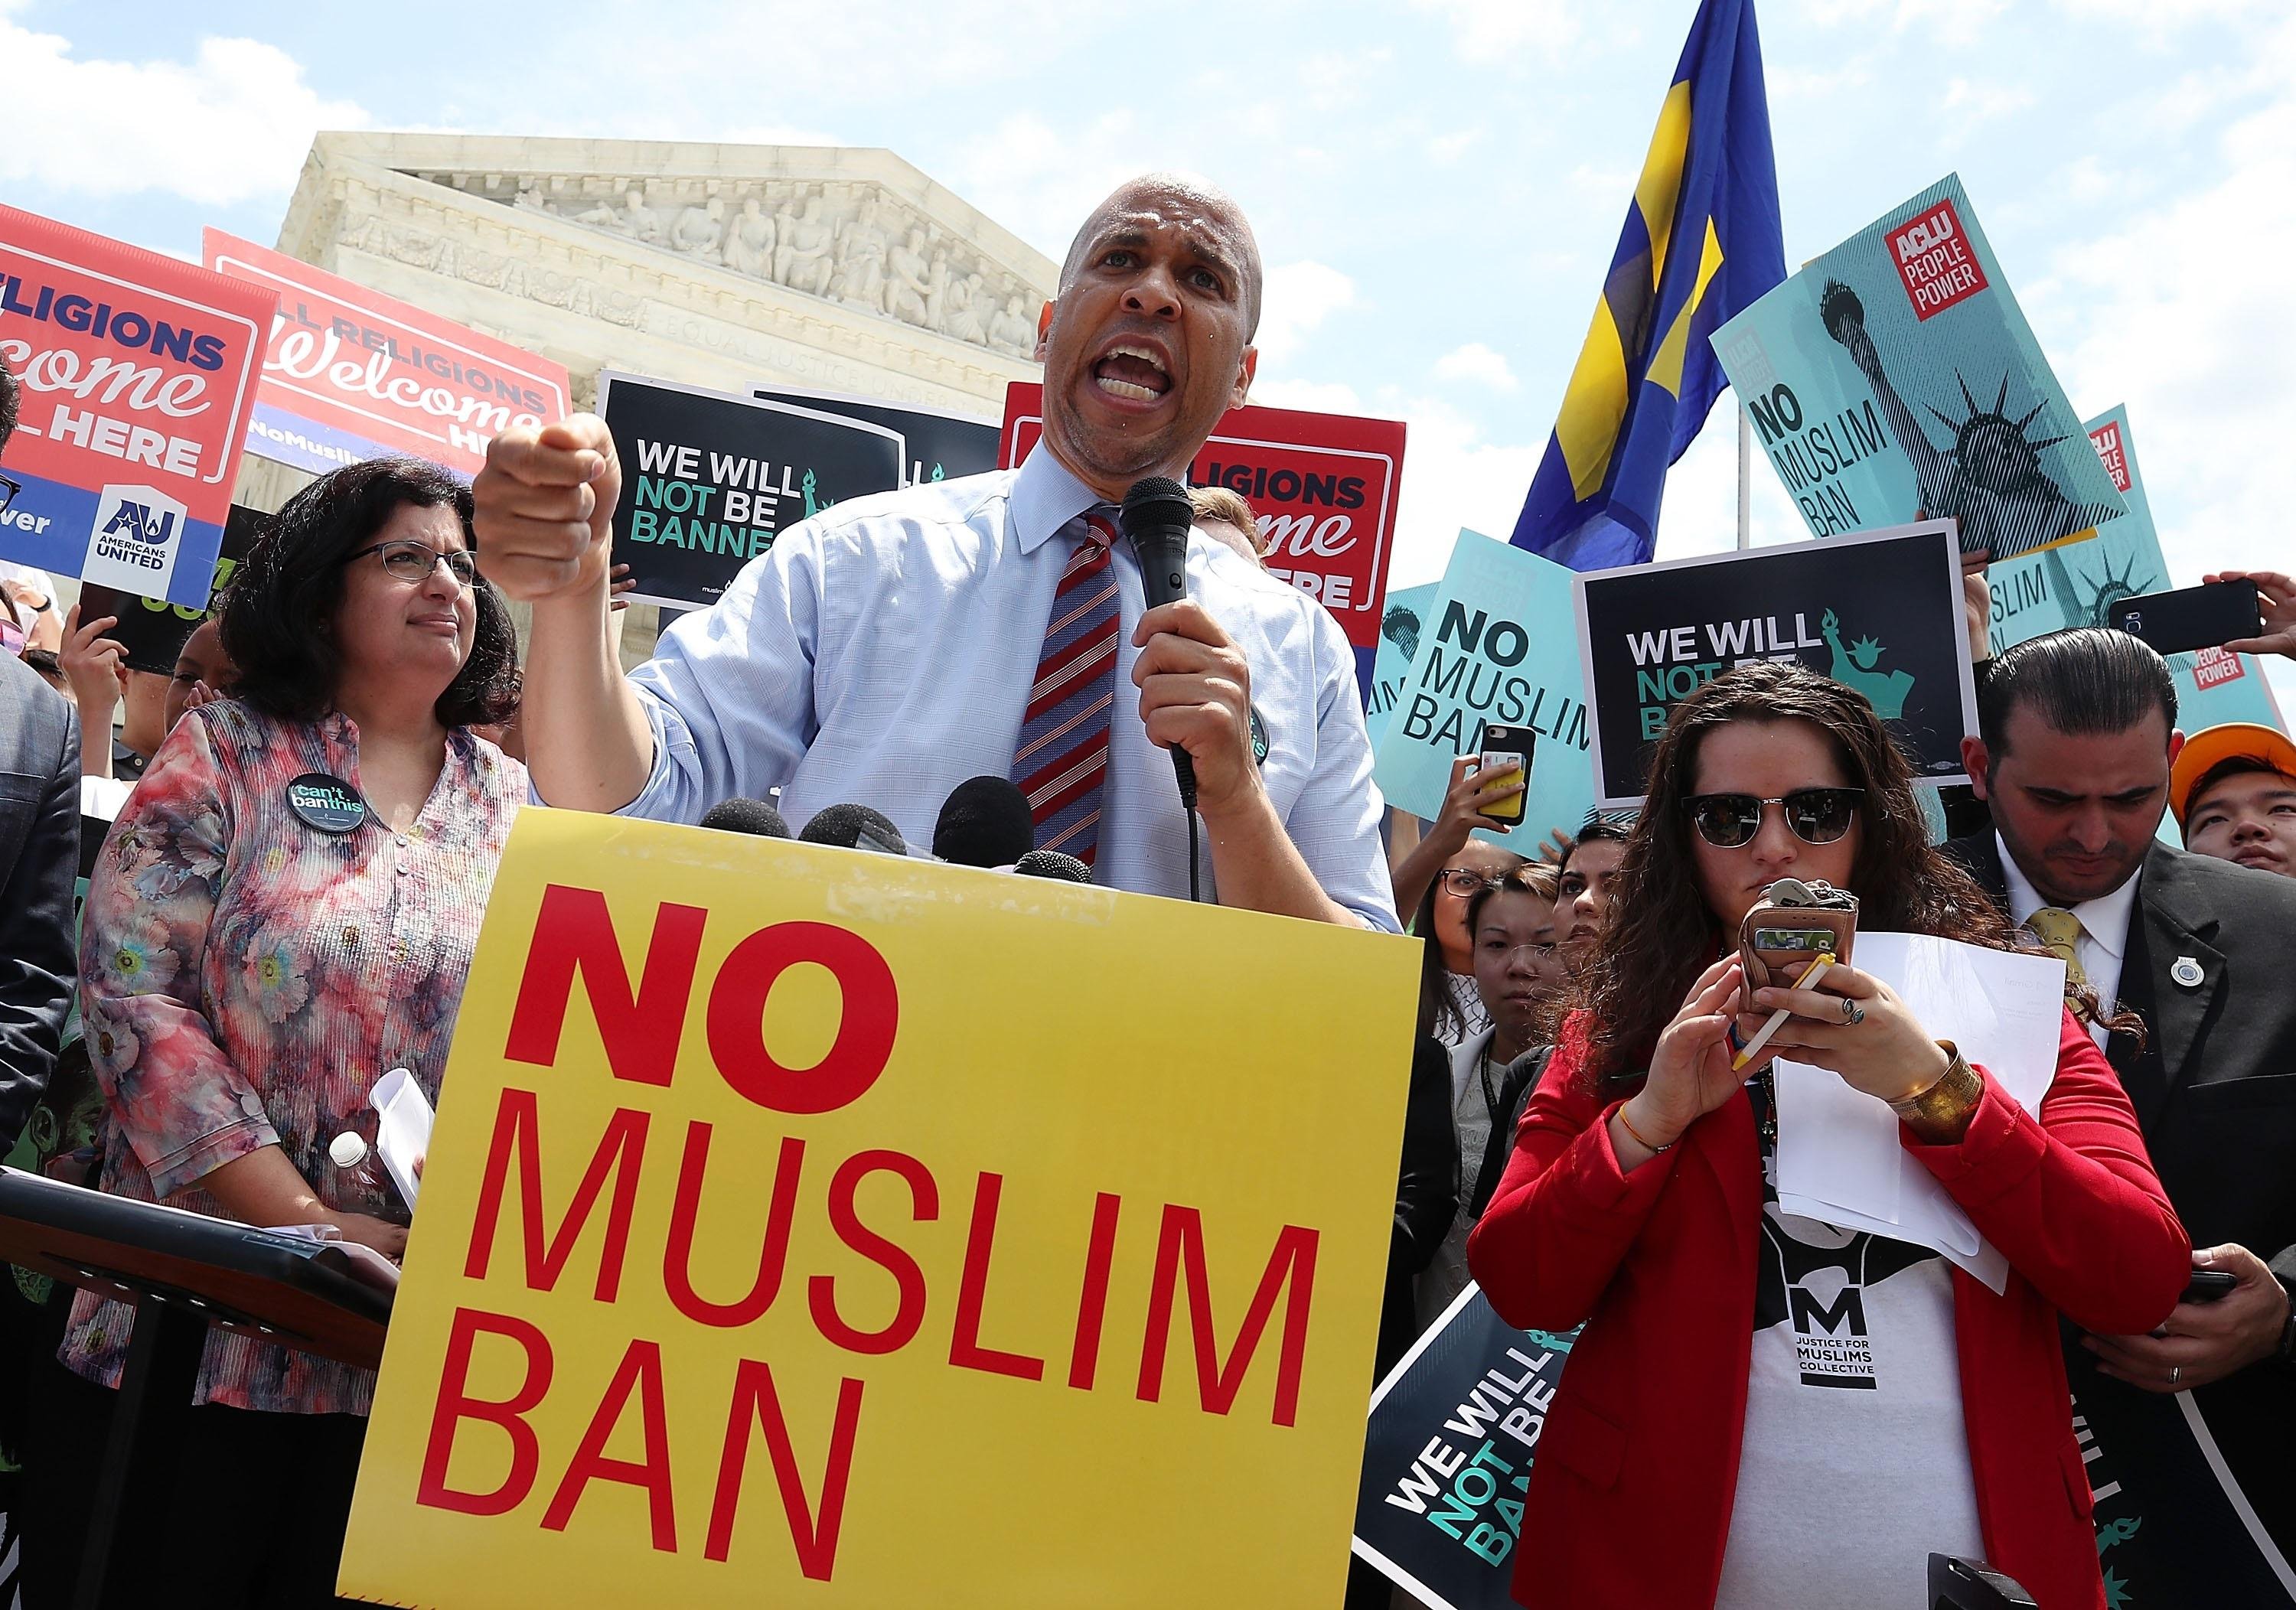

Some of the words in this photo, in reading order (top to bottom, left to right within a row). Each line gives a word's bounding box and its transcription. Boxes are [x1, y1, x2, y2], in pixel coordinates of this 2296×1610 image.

[1895, 210, 1954, 265] ACLU
[1904, 238, 1967, 288] PEOPLE
[1915, 263, 1978, 311] POWER
[0, 273, 227, 371] LIGIONS
[332, 315, 546, 414] RELIGIONS
[48, 403, 203, 478] HERE
[1748, 383, 1803, 445] NO
[637, 438, 702, 480] WE
[709, 451, 801, 498] WILL
[1773, 399, 1887, 494] MUSLIM
[635, 475, 716, 516] NOT
[723, 490, 778, 528] BE
[1799, 480, 1862, 539] BAN
[96, 543, 164, 571] UNITED
[99, 535, 166, 559] AMERICANS
[631, 510, 773, 559] BANNE
[1988, 562, 2047, 627] SLIM
[1437, 599, 1529, 667] NO
[1626, 626, 1698, 666] WE
[1705, 612, 1823, 657] WILL
[2197, 658, 2239, 686] POWER
[297, 785, 345, 800] can't
[503, 883, 899, 1114] NO
[463, 1087, 1320, 1429] MUSLIM
[1796, 1337, 1843, 1348] JUSTICE
[1845, 1340, 1870, 1348] FOR
[1796, 1347, 1872, 1363] MUSLIMS
[1799, 1361, 1874, 1374] COLLECTIVE
[416, 1307, 865, 1583] BAN
[1384, 1435, 1467, 1515] WE
[1443, 1347, 1554, 1439] WILL
[1426, 1439, 1514, 1541] NOT
